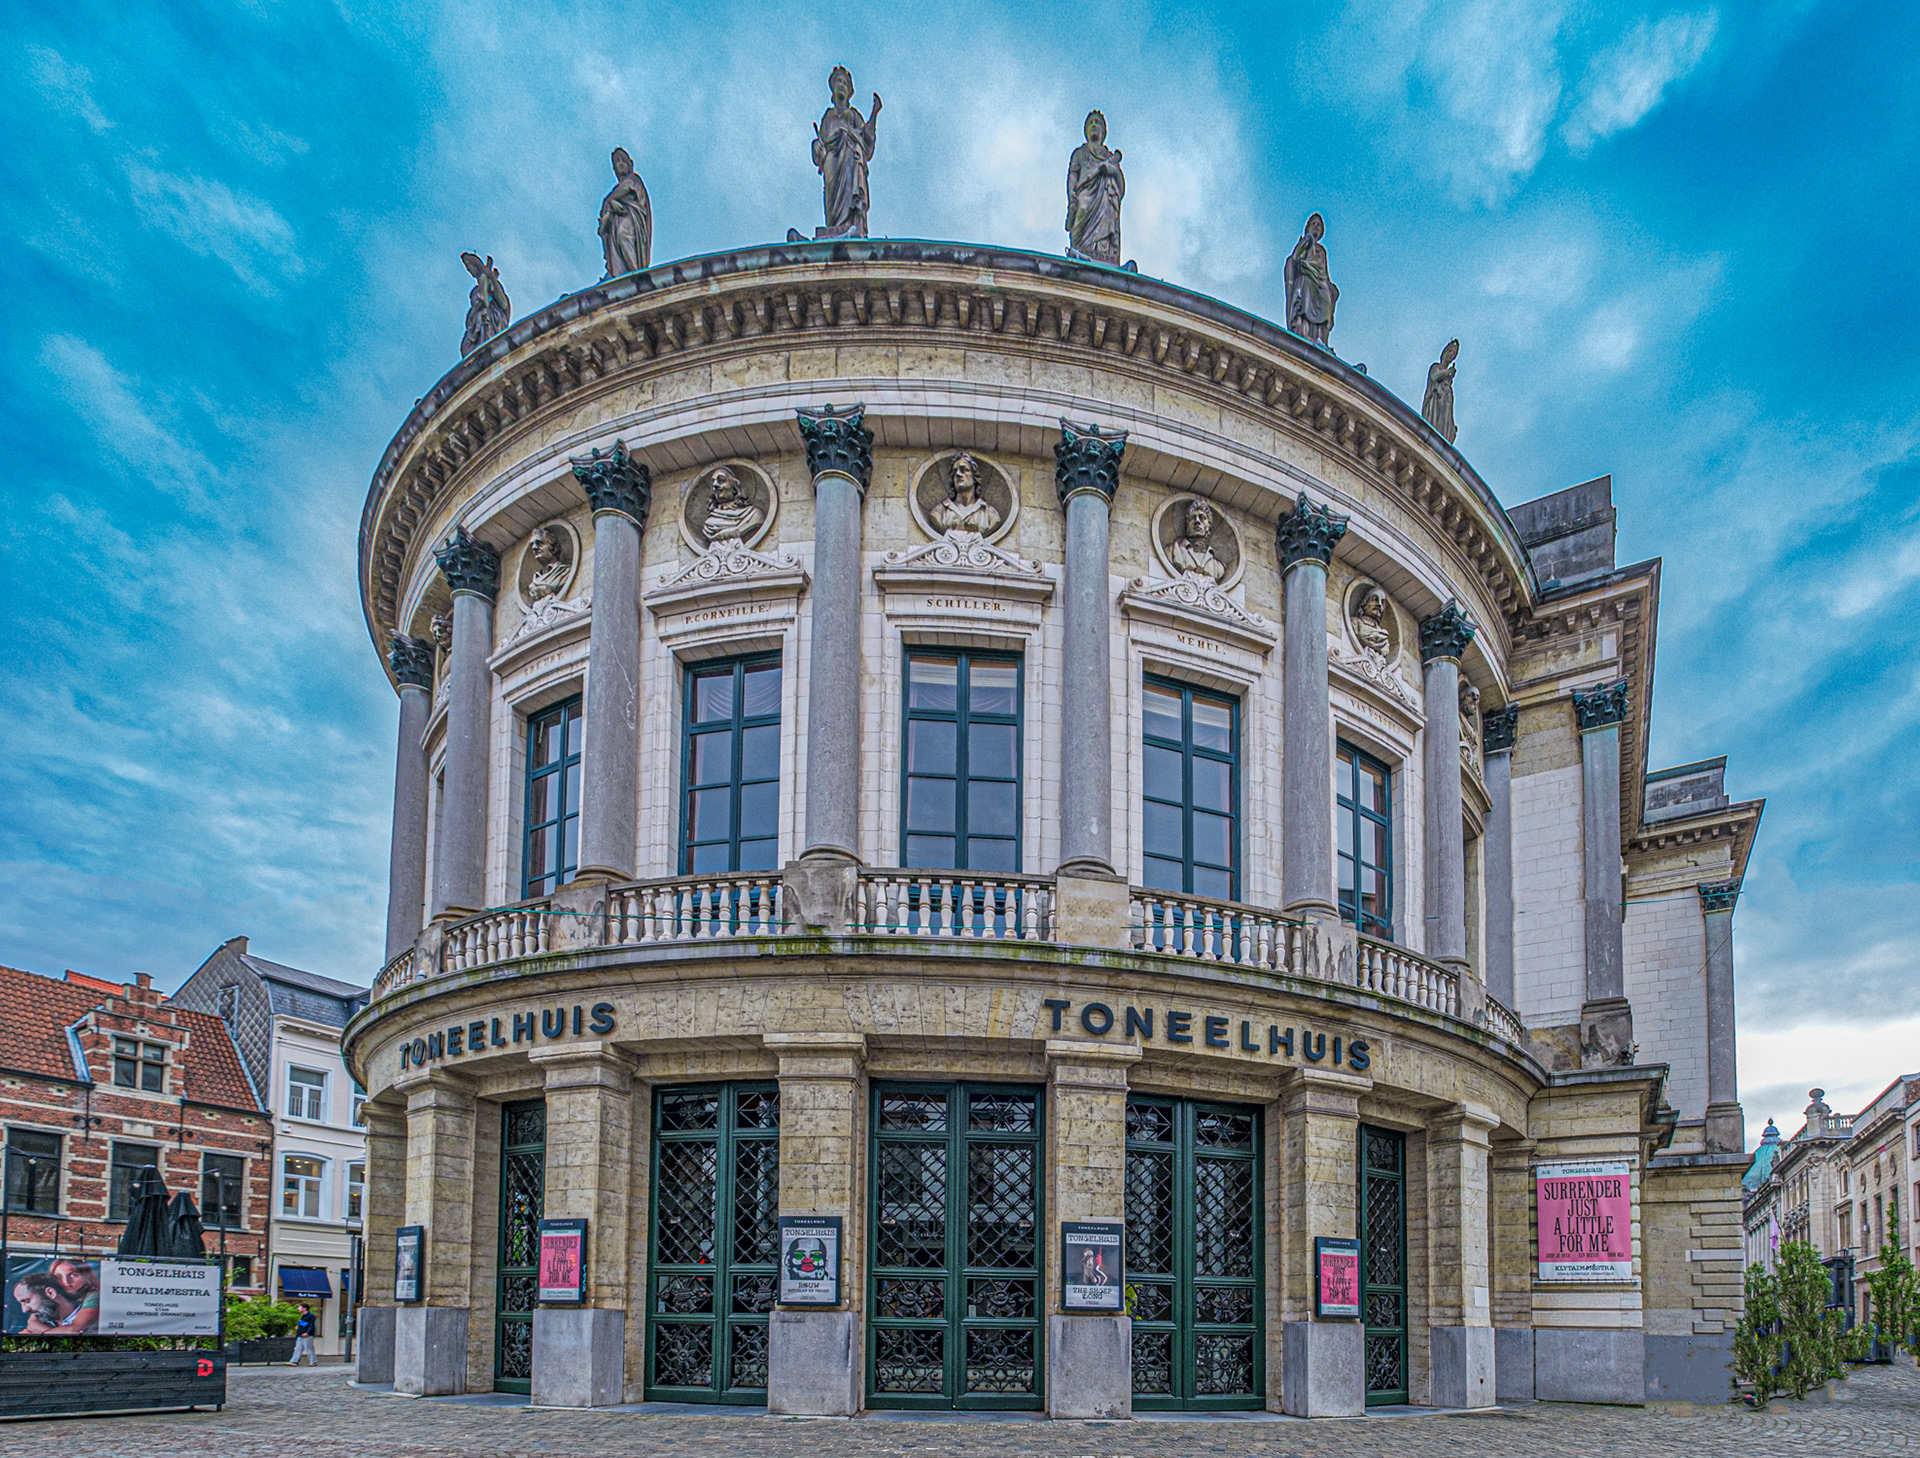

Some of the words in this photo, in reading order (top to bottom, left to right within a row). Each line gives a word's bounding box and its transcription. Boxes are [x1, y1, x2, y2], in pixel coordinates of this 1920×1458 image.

[927, 598, 1005, 611] SCHILLER.
[1177, 634, 1226, 655] MEHUL.
[400, 1002, 614, 1069] TONEELHUIS
[1044, 999, 1371, 1070] TONEELHUIS
[1544, 1180, 1622, 1200] SURRENDER
[1567, 1198, 1598, 1217] JUST
[1553, 1217, 1562, 1235] A
[1567, 1216, 1614, 1234] LITTLE
[543, 1237, 578, 1249] SURRENDER
[1559, 1234, 1583, 1252] FOR
[1589, 1234, 1609, 1252] ME
